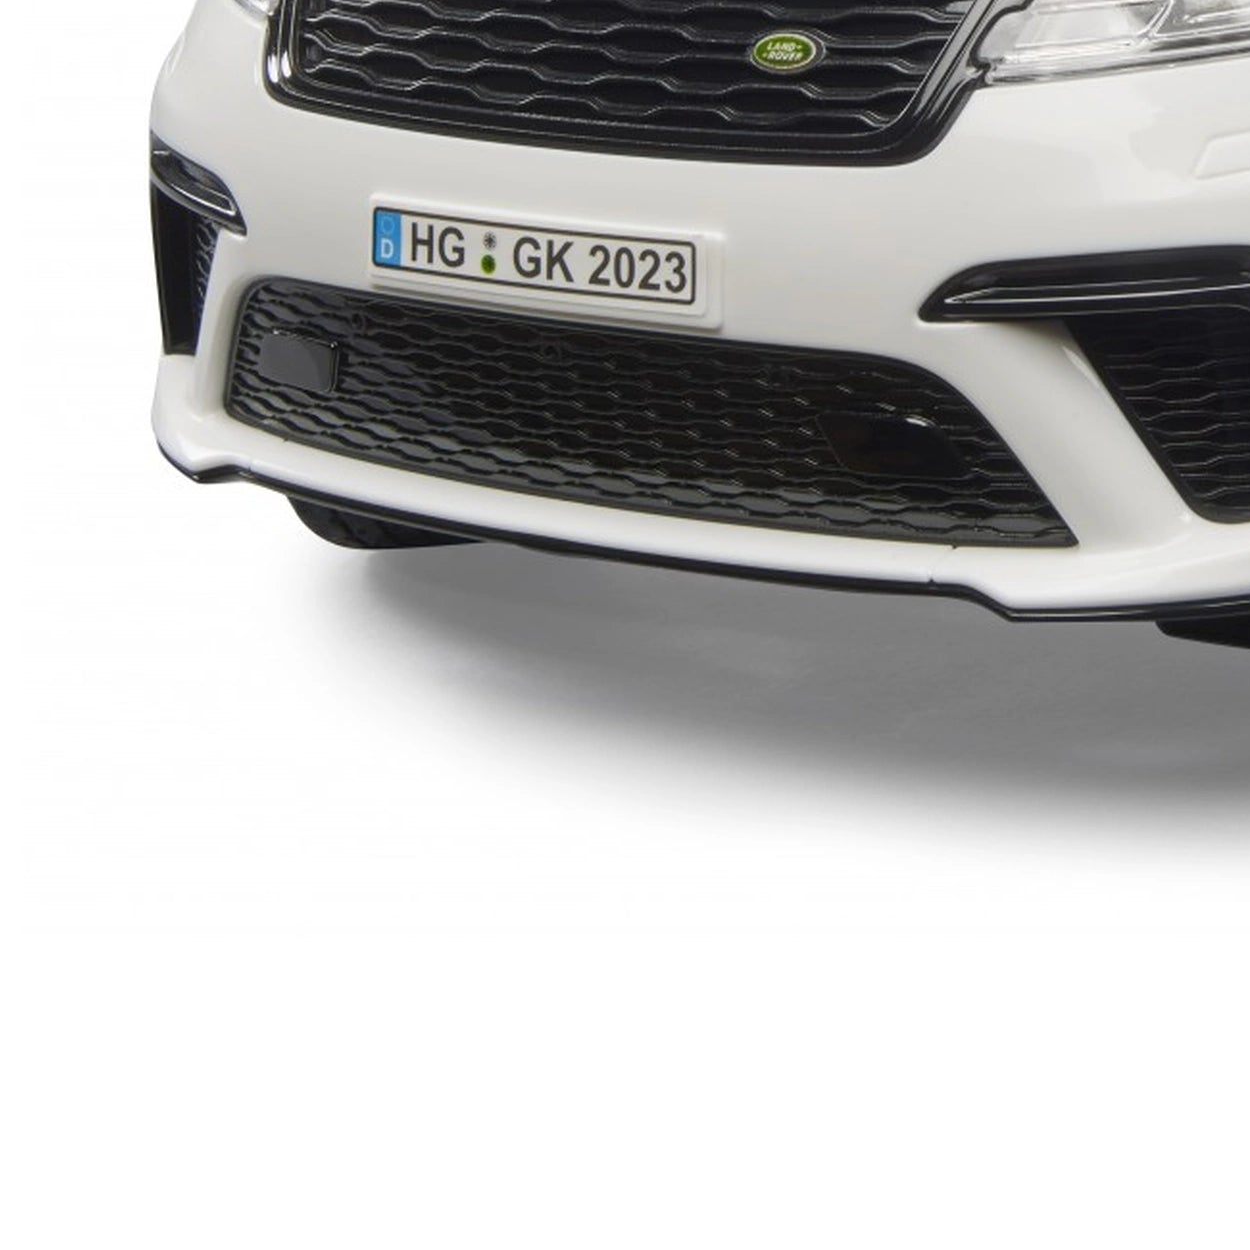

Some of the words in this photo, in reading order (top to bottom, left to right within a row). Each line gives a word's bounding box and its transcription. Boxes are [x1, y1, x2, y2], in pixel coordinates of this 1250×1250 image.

[380, 238, 394, 259] D
[411, 222, 465, 268] HG
[513, 236, 574, 283] GK
[588, 244, 687, 293] 2023
